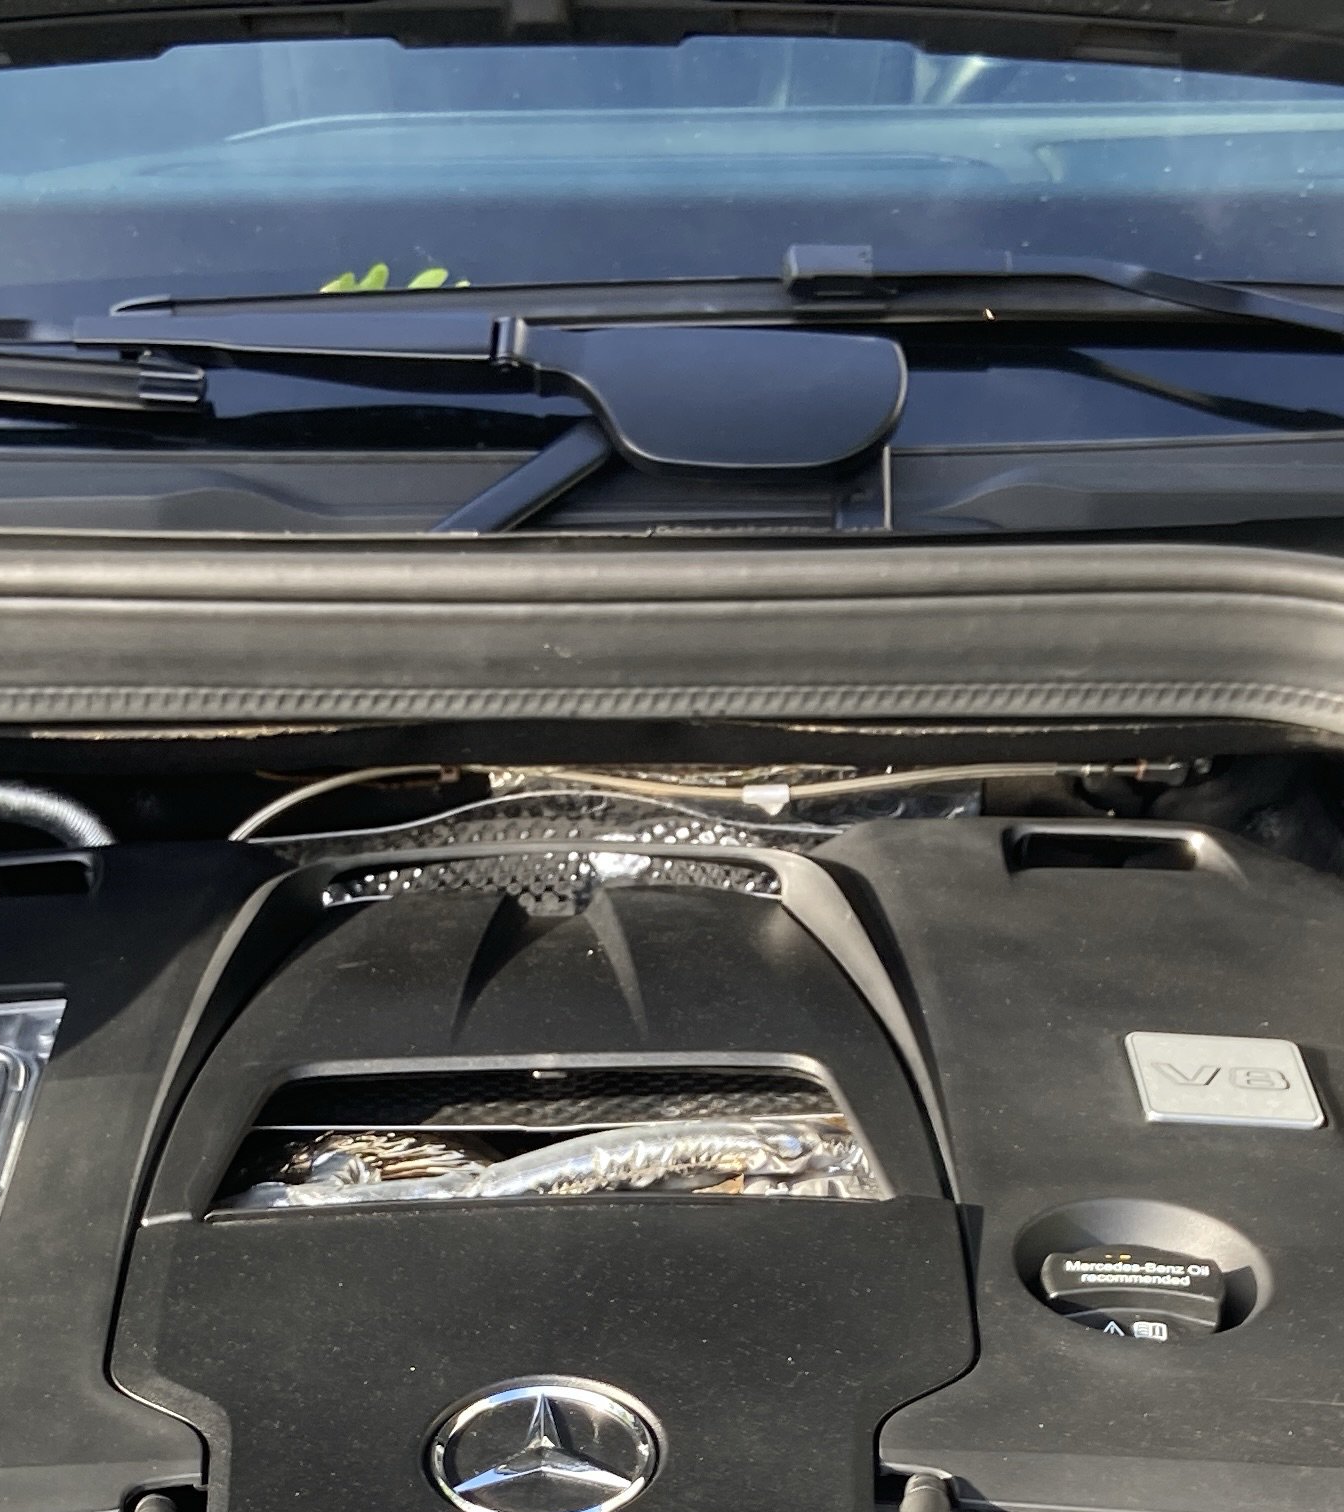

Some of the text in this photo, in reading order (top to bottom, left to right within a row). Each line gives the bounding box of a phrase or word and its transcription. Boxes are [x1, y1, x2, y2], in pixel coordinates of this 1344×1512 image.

[1150, 1061, 1291, 1091] V8
[1064, 1260, 1210, 1276] Mercedes-Benz Oil
[1080, 1273, 1191, 1287] recommended
